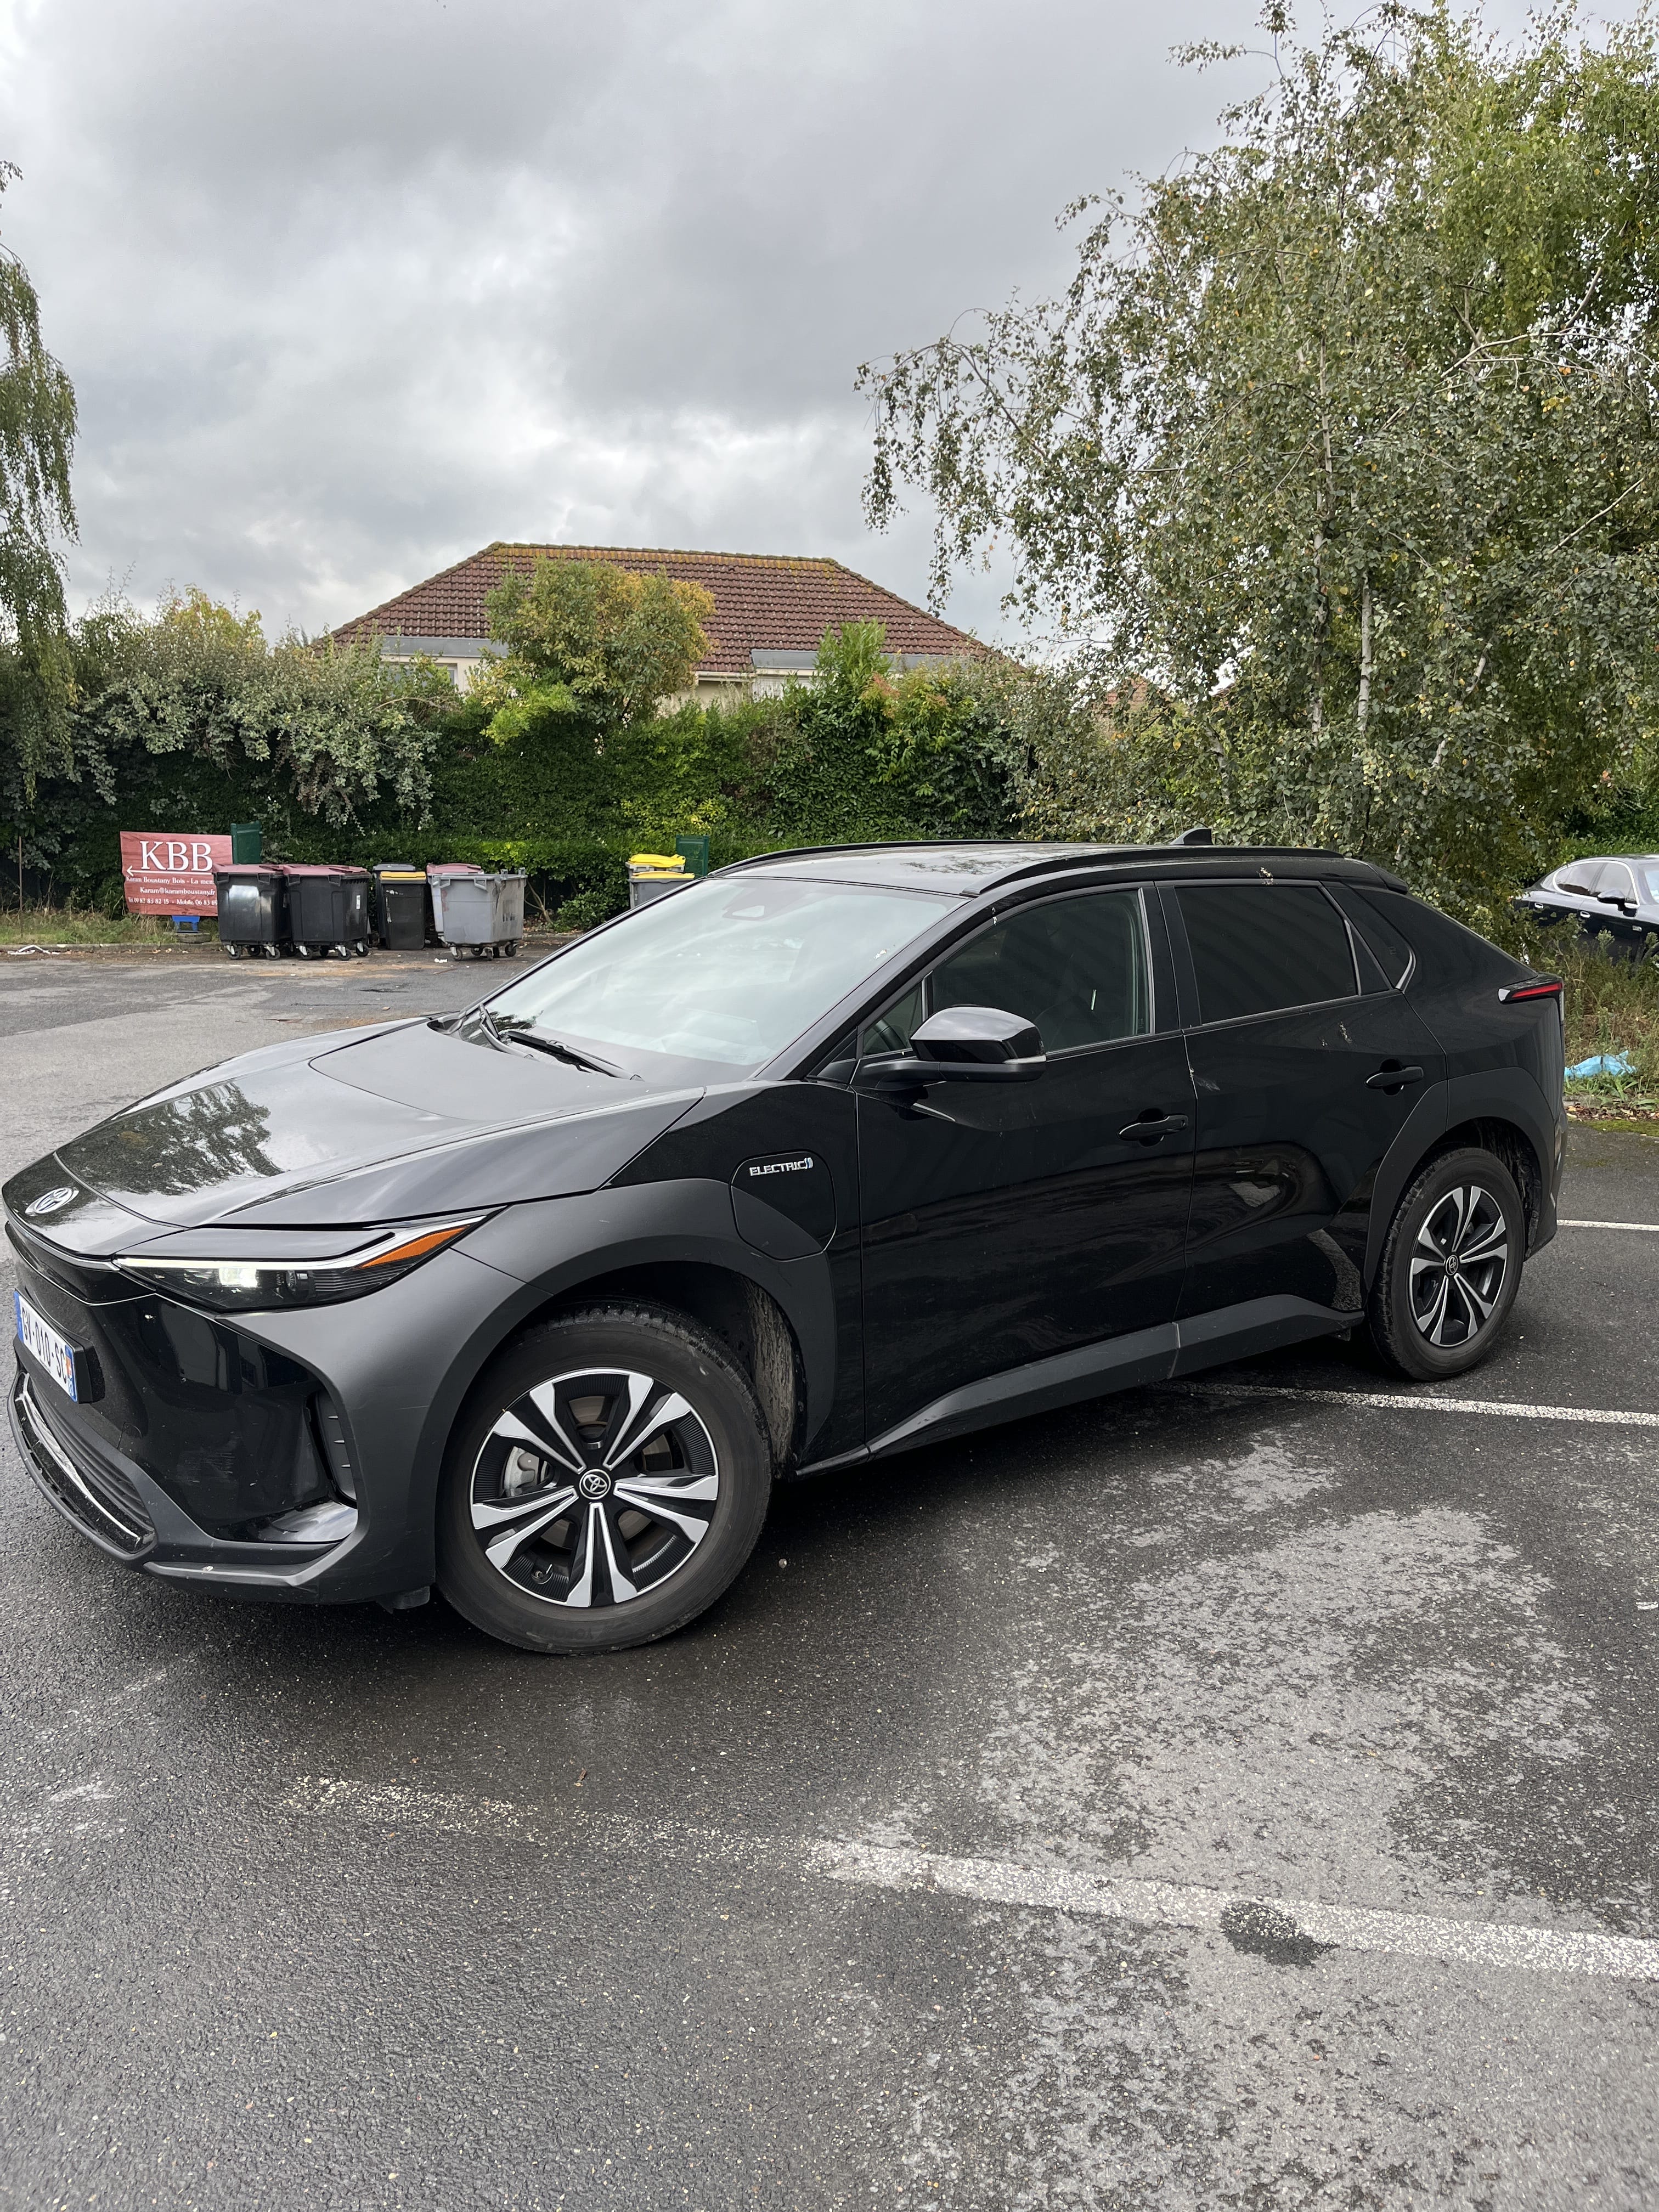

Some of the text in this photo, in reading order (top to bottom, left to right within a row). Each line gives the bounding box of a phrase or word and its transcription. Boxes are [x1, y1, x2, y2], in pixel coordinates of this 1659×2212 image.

[140, 840, 213, 872] KBB
[143, 876, 171, 884] Boustany
[140, 887, 215, 896] Karam@karamboustany.fr
[749, 1160, 806, 1176] ELECTRIC
